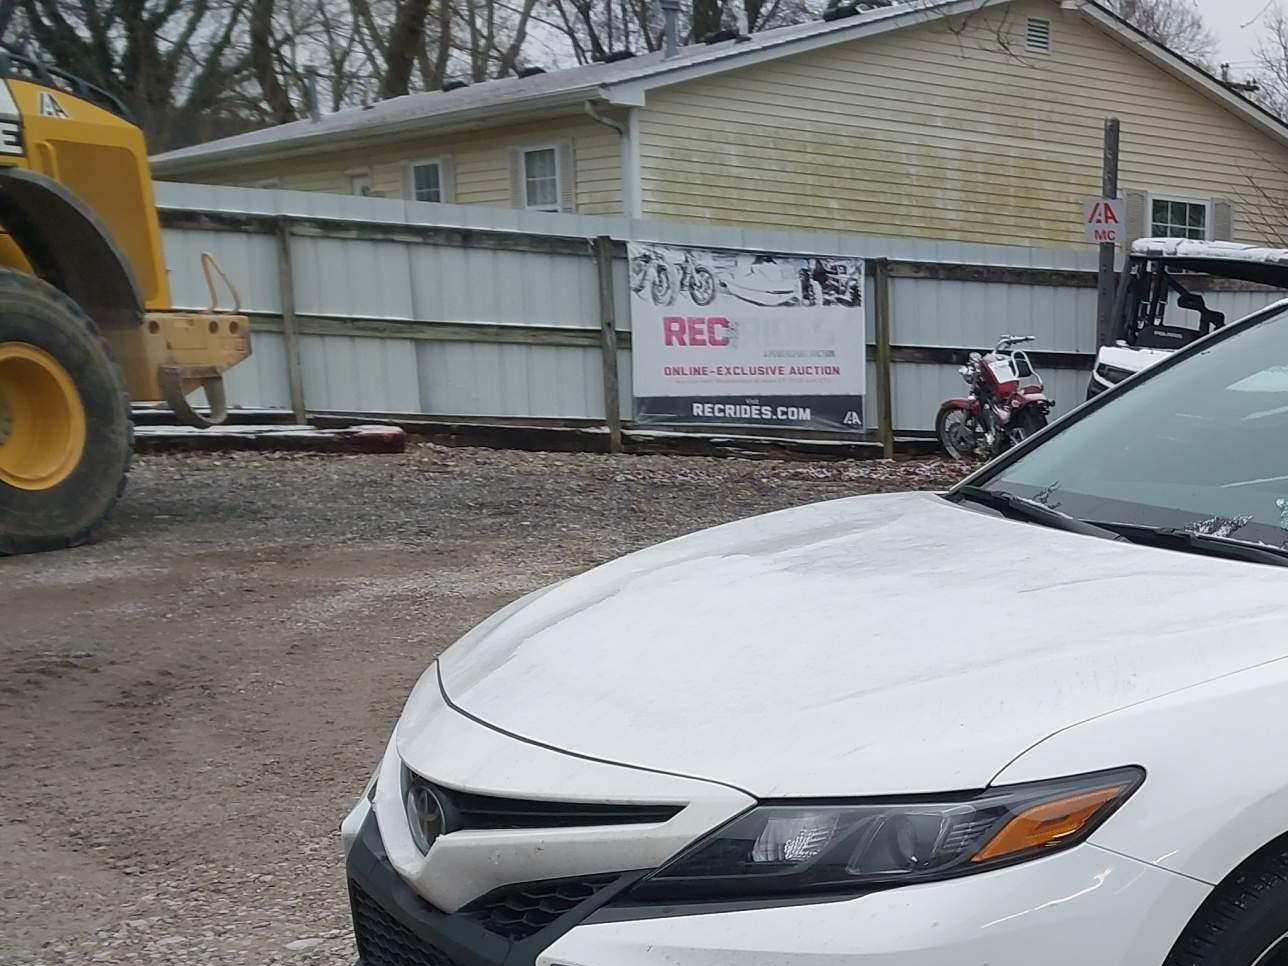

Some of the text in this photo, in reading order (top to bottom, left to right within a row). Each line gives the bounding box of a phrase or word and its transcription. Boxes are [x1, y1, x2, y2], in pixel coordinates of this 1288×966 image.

[1094, 230, 1116, 241] MC
[663, 316, 731, 347] REC
[664, 365, 841, 376] ONLINE-EXCLUSIVE AUCTION
[692, 403, 812, 421] RECRIDES.COM
